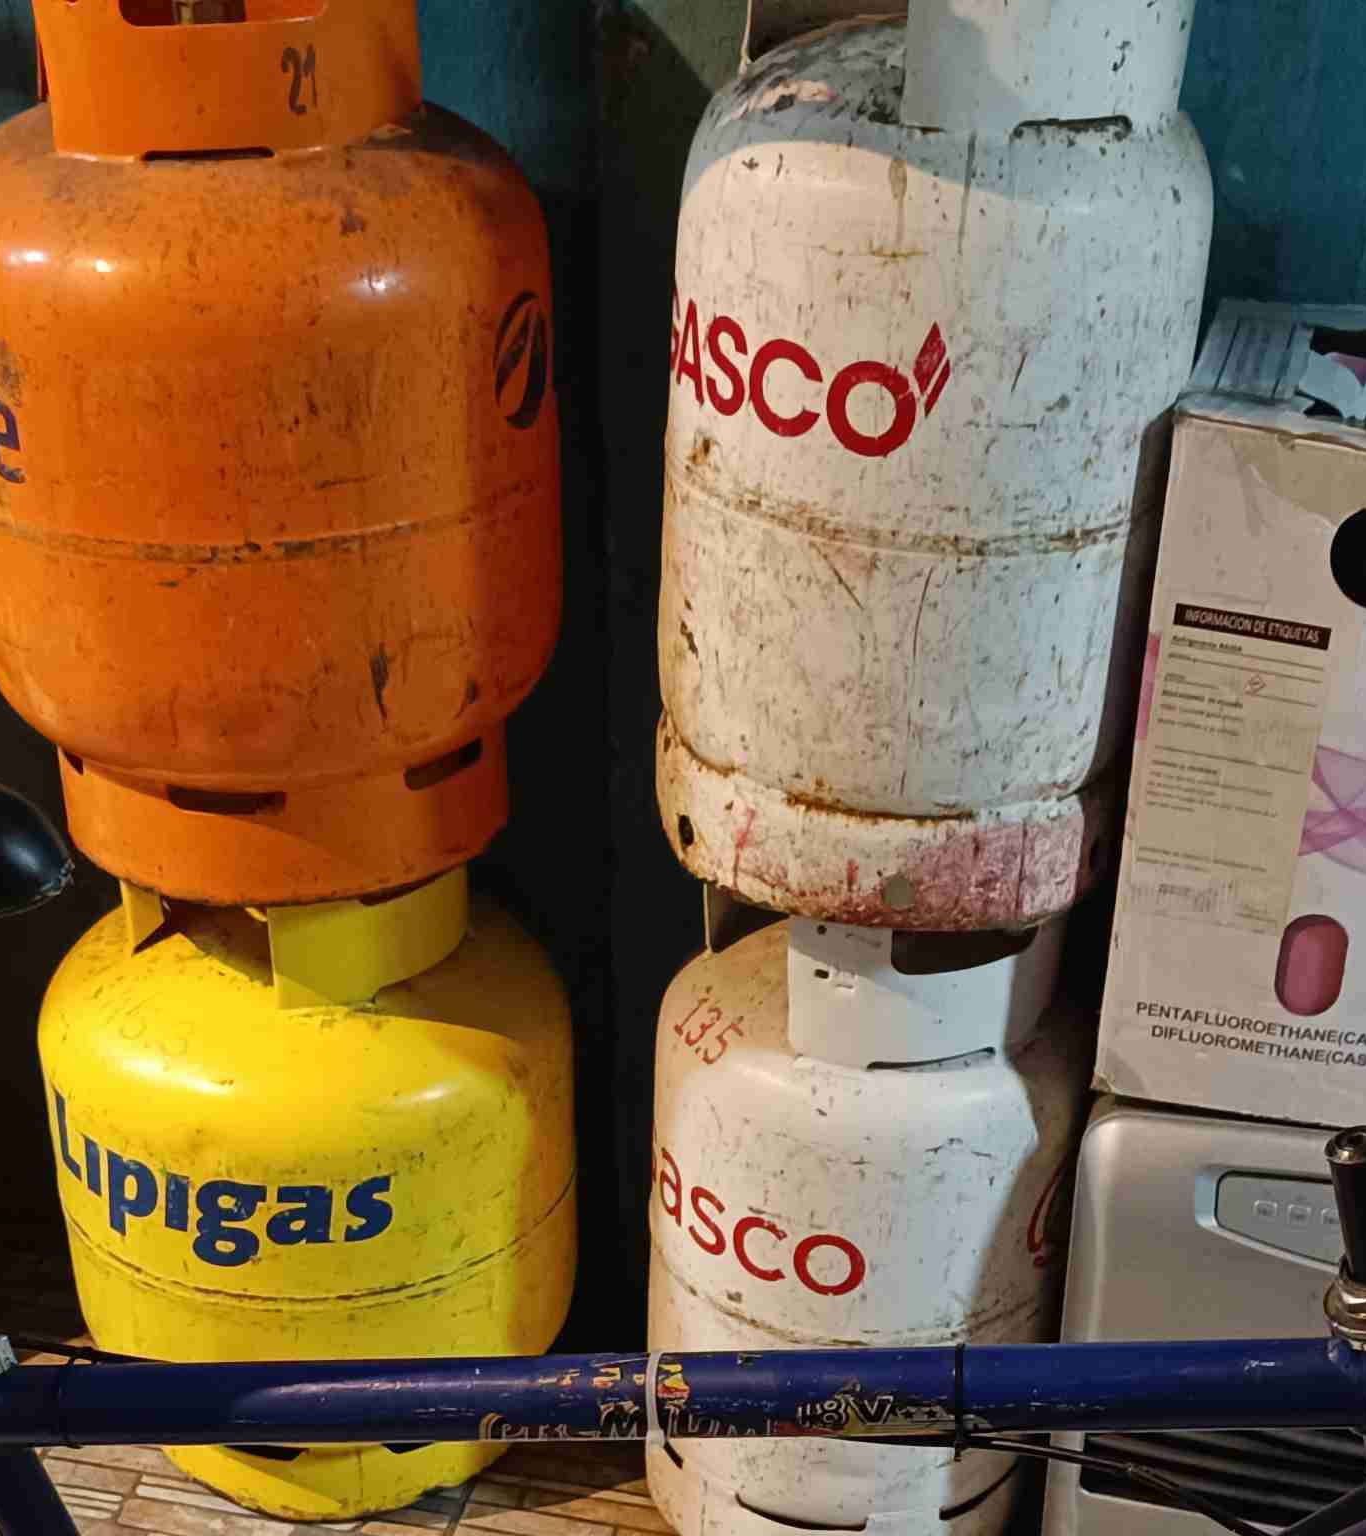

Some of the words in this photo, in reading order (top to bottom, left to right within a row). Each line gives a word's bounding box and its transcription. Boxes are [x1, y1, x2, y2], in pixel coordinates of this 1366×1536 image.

[281, 43, 319, 117] 21
[1184, 608, 1253, 633] INFORMACION
[1267, 622, 1321, 643] ETIQUETAS
[51, 1085, 393, 1267] Lipigas
[653, 1130, 866, 1297] asco
